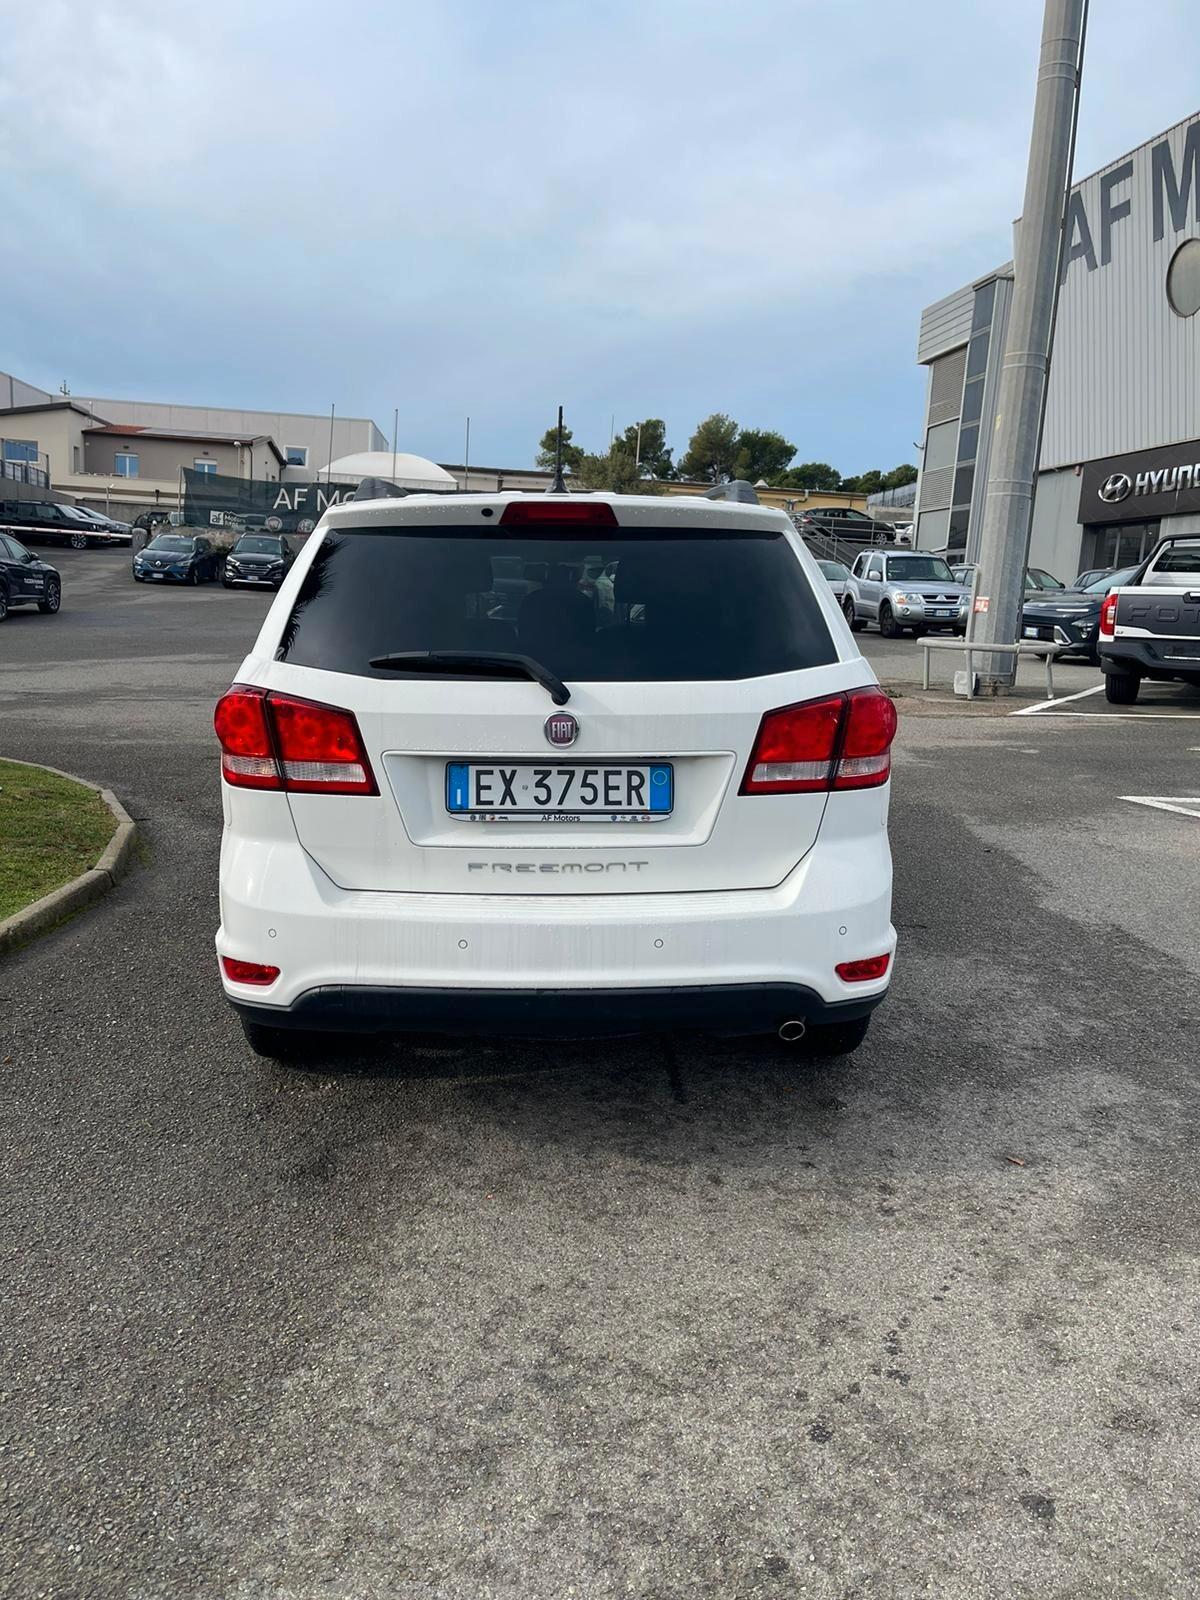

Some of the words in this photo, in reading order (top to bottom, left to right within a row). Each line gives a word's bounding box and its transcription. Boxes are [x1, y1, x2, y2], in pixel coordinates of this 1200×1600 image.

[1060, 159, 1133, 286] AF
[273, 488, 308, 510] AF
[552, 722, 573, 738] FIAT
[475, 769, 517, 806] EX
[533, 769, 646, 806] 375ER
[554, 814, 580, 822] Motors
[467, 861, 649, 873] FREEMONT
